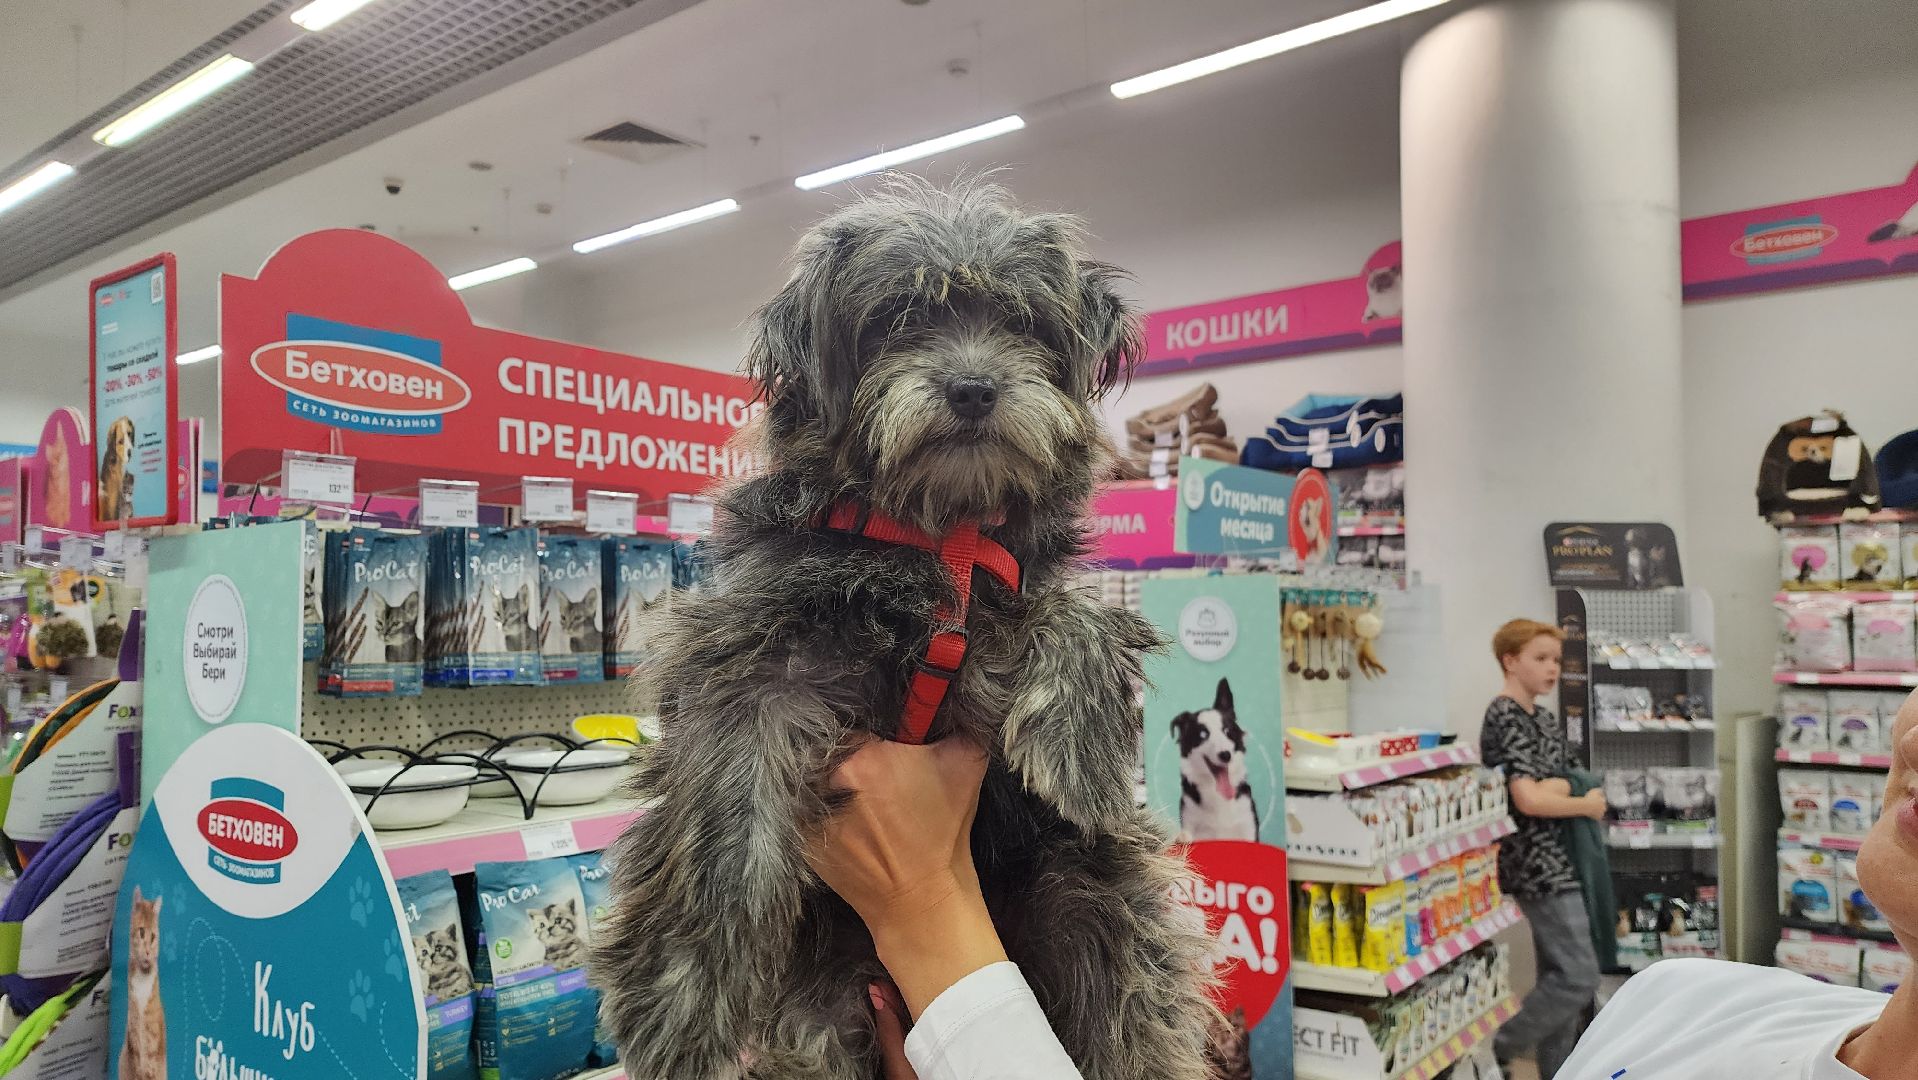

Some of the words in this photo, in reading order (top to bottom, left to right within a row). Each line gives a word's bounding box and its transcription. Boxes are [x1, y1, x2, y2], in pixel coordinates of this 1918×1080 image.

[1166, 303, 1289, 351] КОШКИ
[286, 349, 443, 400] Бетховен
[293, 400, 327, 417] СЕТЬ
[333, 410, 437, 428] ЗООМАГАЗИНОВ
[498, 416, 754, 479] ПРЕДЛОЖЕНИ
[1210, 480, 1286, 517] Открытие
[1220, 517, 1275, 544] месяца
[197, 622, 234, 642] Смотри
[193, 642, 238, 663] Выбирай
[208, 812, 285, 849] БЕТХОВЕН
[254, 960, 316, 1061] Клуб
[1330, 1032, 1360, 1057] FIT
